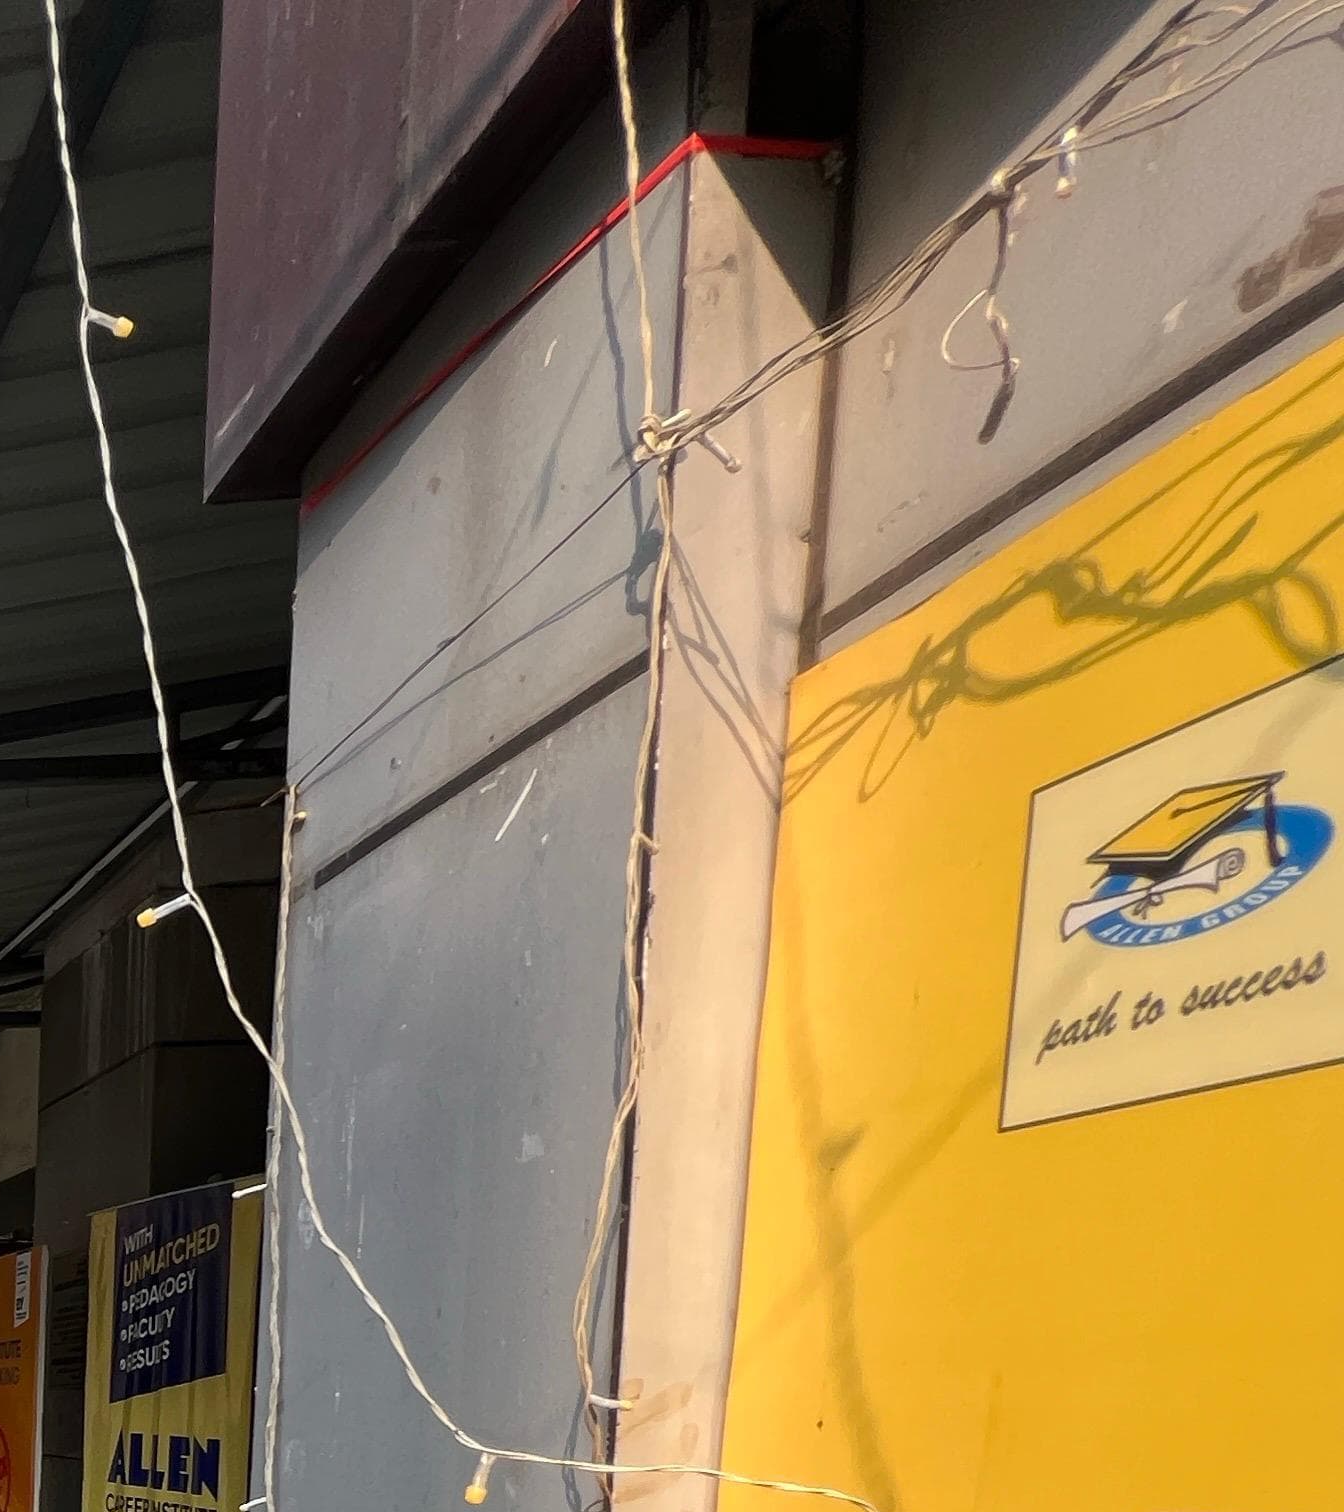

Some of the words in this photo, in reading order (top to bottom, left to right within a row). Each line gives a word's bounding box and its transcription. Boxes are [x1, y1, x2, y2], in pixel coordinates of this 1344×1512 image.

[1096, 924, 1183, 944] ALLEN
[1201, 864, 1303, 929] GROUP
[1035, 990, 1122, 1065] path
[1131, 991, 1165, 1031] to
[1180, 950, 1328, 1017] success
[123, 1223, 220, 1287] UNMATCHED
[124, 1224, 154, 1255] WITH
[107, 1426, 220, 1502] ALLEN
